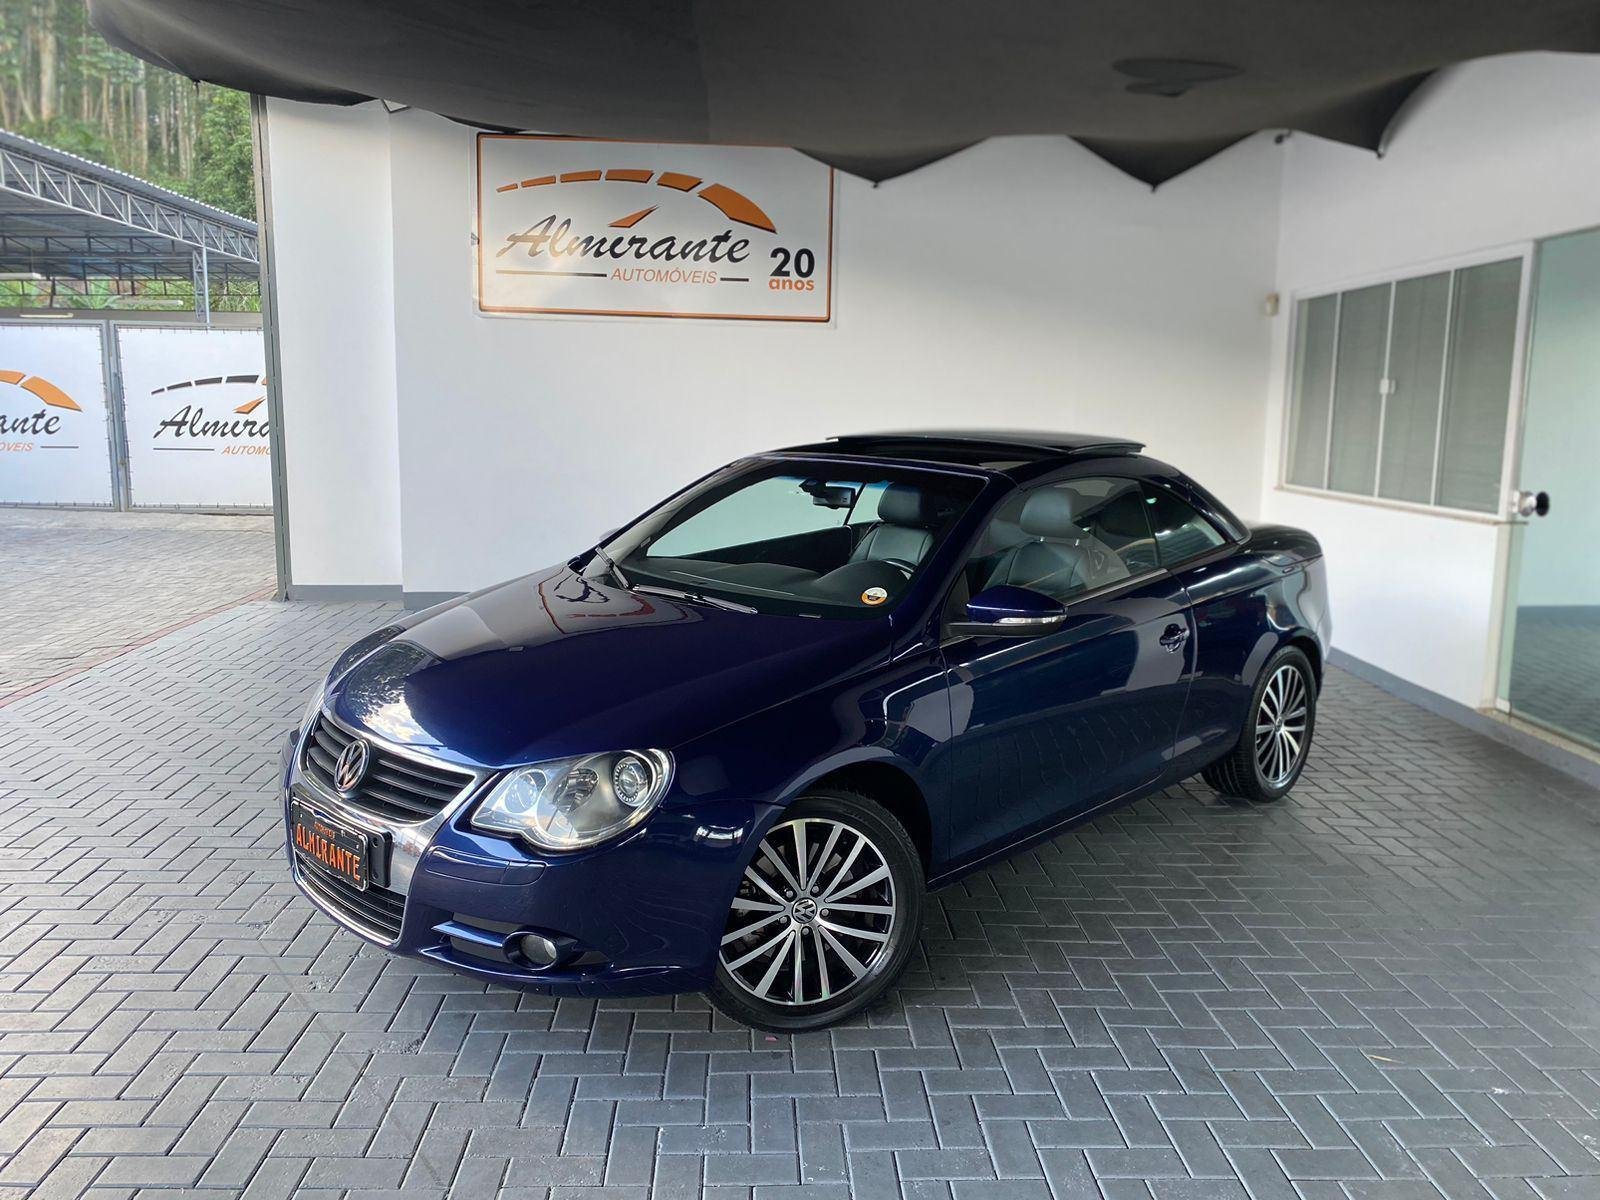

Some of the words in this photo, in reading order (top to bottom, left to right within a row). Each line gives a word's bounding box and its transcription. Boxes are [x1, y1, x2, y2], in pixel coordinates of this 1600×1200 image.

[495, 214, 749, 264] Almirante
[610, 266, 718, 285] AUTOMÓVEIS
[769, 247, 816, 278] 20
[768, 277, 815, 292] anos
[296, 822, 361, 881] ALMIRANTE
